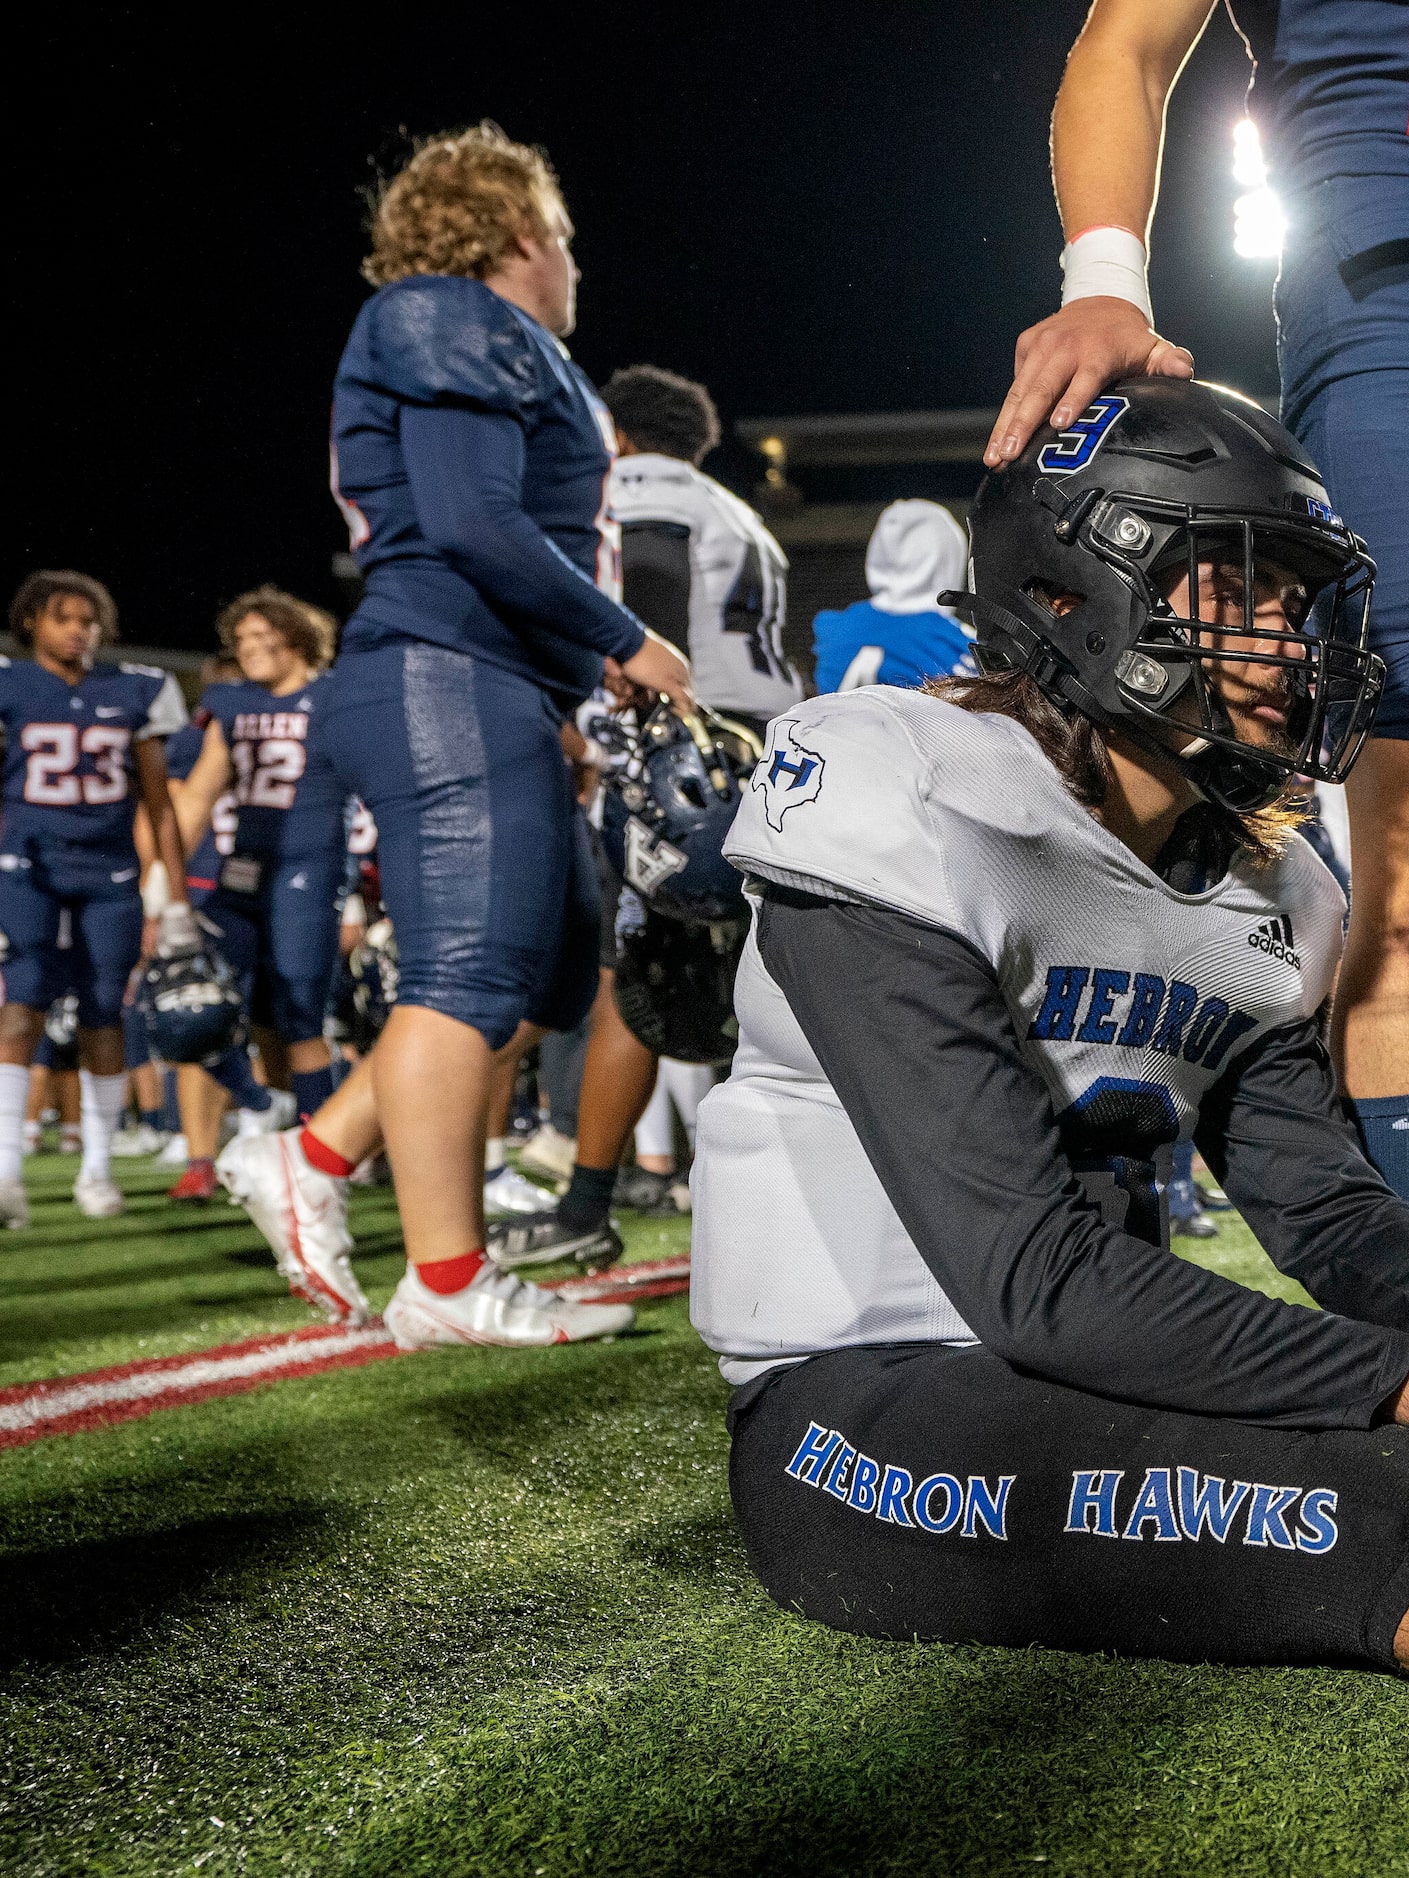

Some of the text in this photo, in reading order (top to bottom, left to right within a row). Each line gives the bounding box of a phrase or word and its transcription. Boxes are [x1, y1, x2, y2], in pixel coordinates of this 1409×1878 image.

[20, 721, 132, 806] 23
[767, 749, 819, 792] H
[1247, 933, 1301, 971] adidas
[783, 1420, 1339, 1555] HEBRON HAWKS
